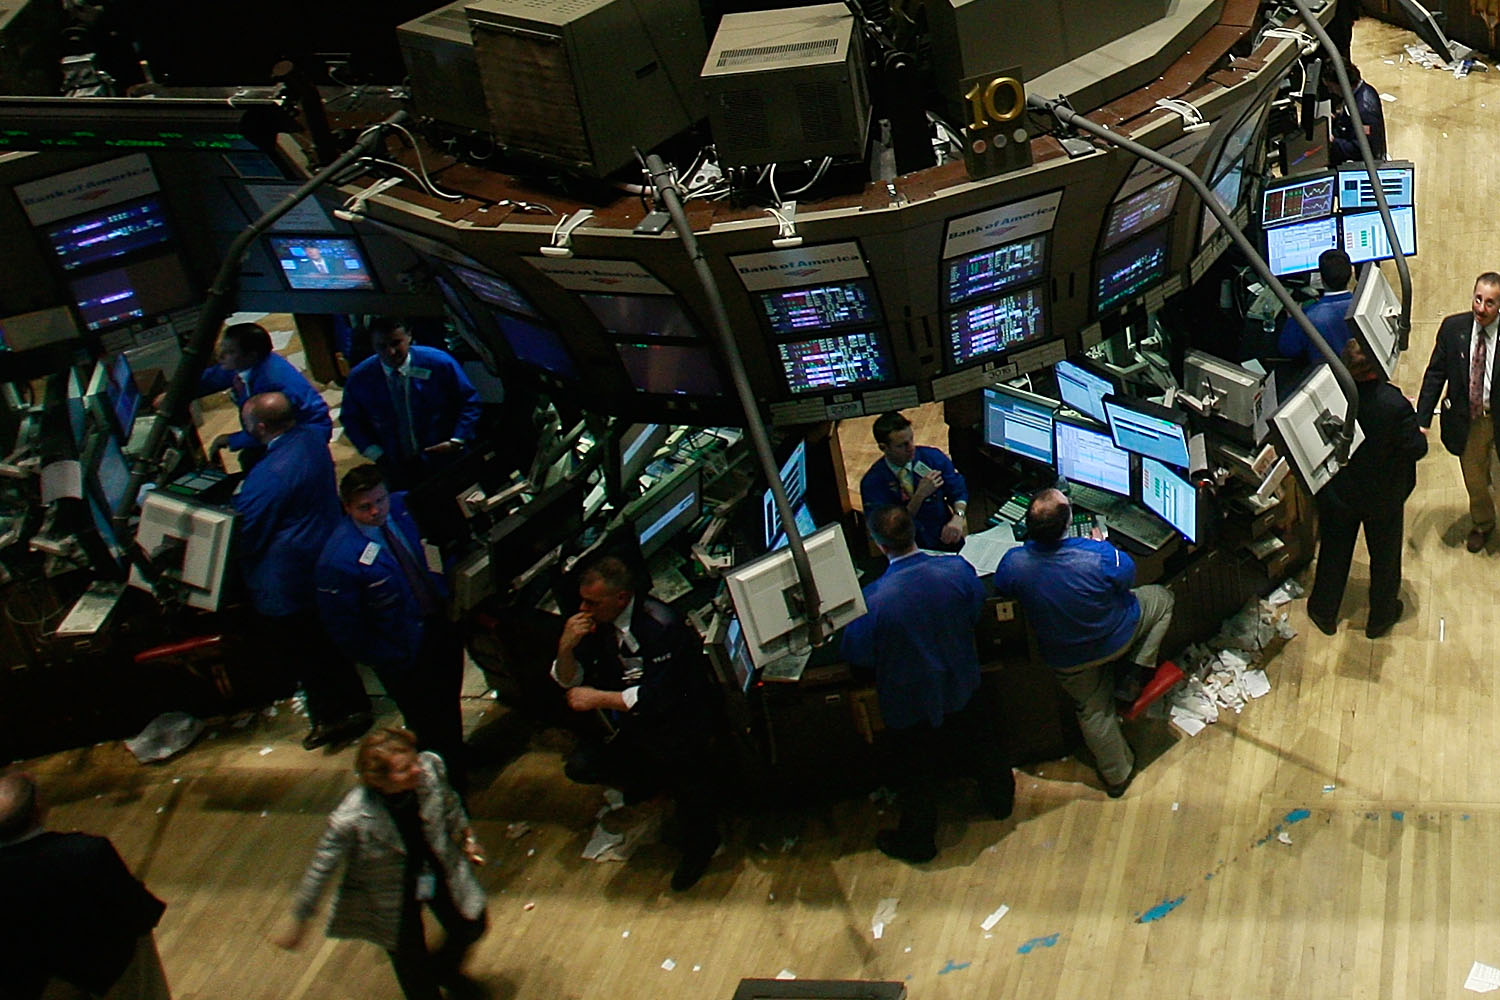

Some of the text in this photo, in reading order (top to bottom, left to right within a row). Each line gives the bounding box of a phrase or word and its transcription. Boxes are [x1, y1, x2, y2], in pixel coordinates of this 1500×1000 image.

[965, 77, 1025, 130] 10
[948, 226, 984, 241] Bank
[1000, 205, 1057, 225] America
[738, 264, 778, 275] Bank
[796, 254, 860, 268] America
